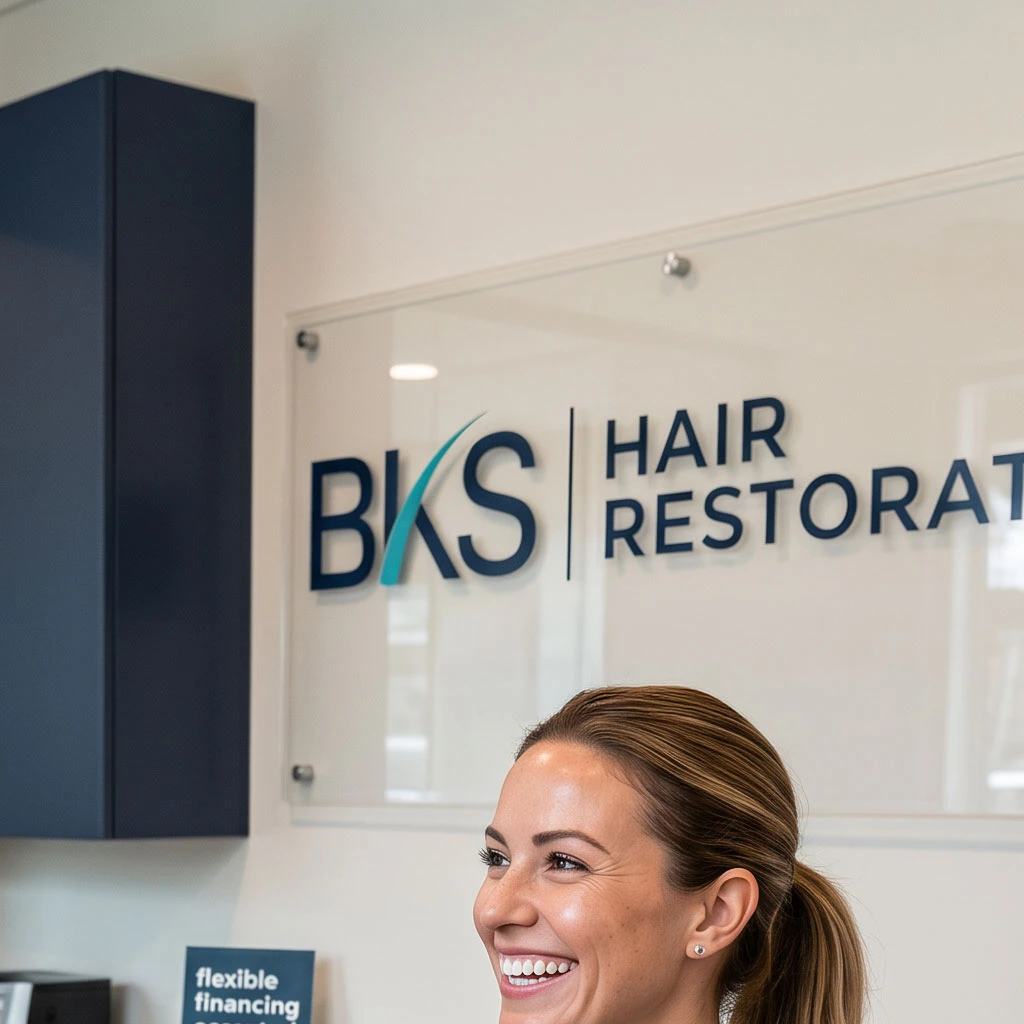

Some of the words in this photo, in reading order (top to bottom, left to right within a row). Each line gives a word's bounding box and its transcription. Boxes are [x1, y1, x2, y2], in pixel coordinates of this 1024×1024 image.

[605, 396, 787, 480] HAIR
[309, 411, 537, 592] BKS
[604, 452, 1024, 559] RESTORAT
[194, 992, 300, 1021] financing
[195, 967, 279, 990] flexible
